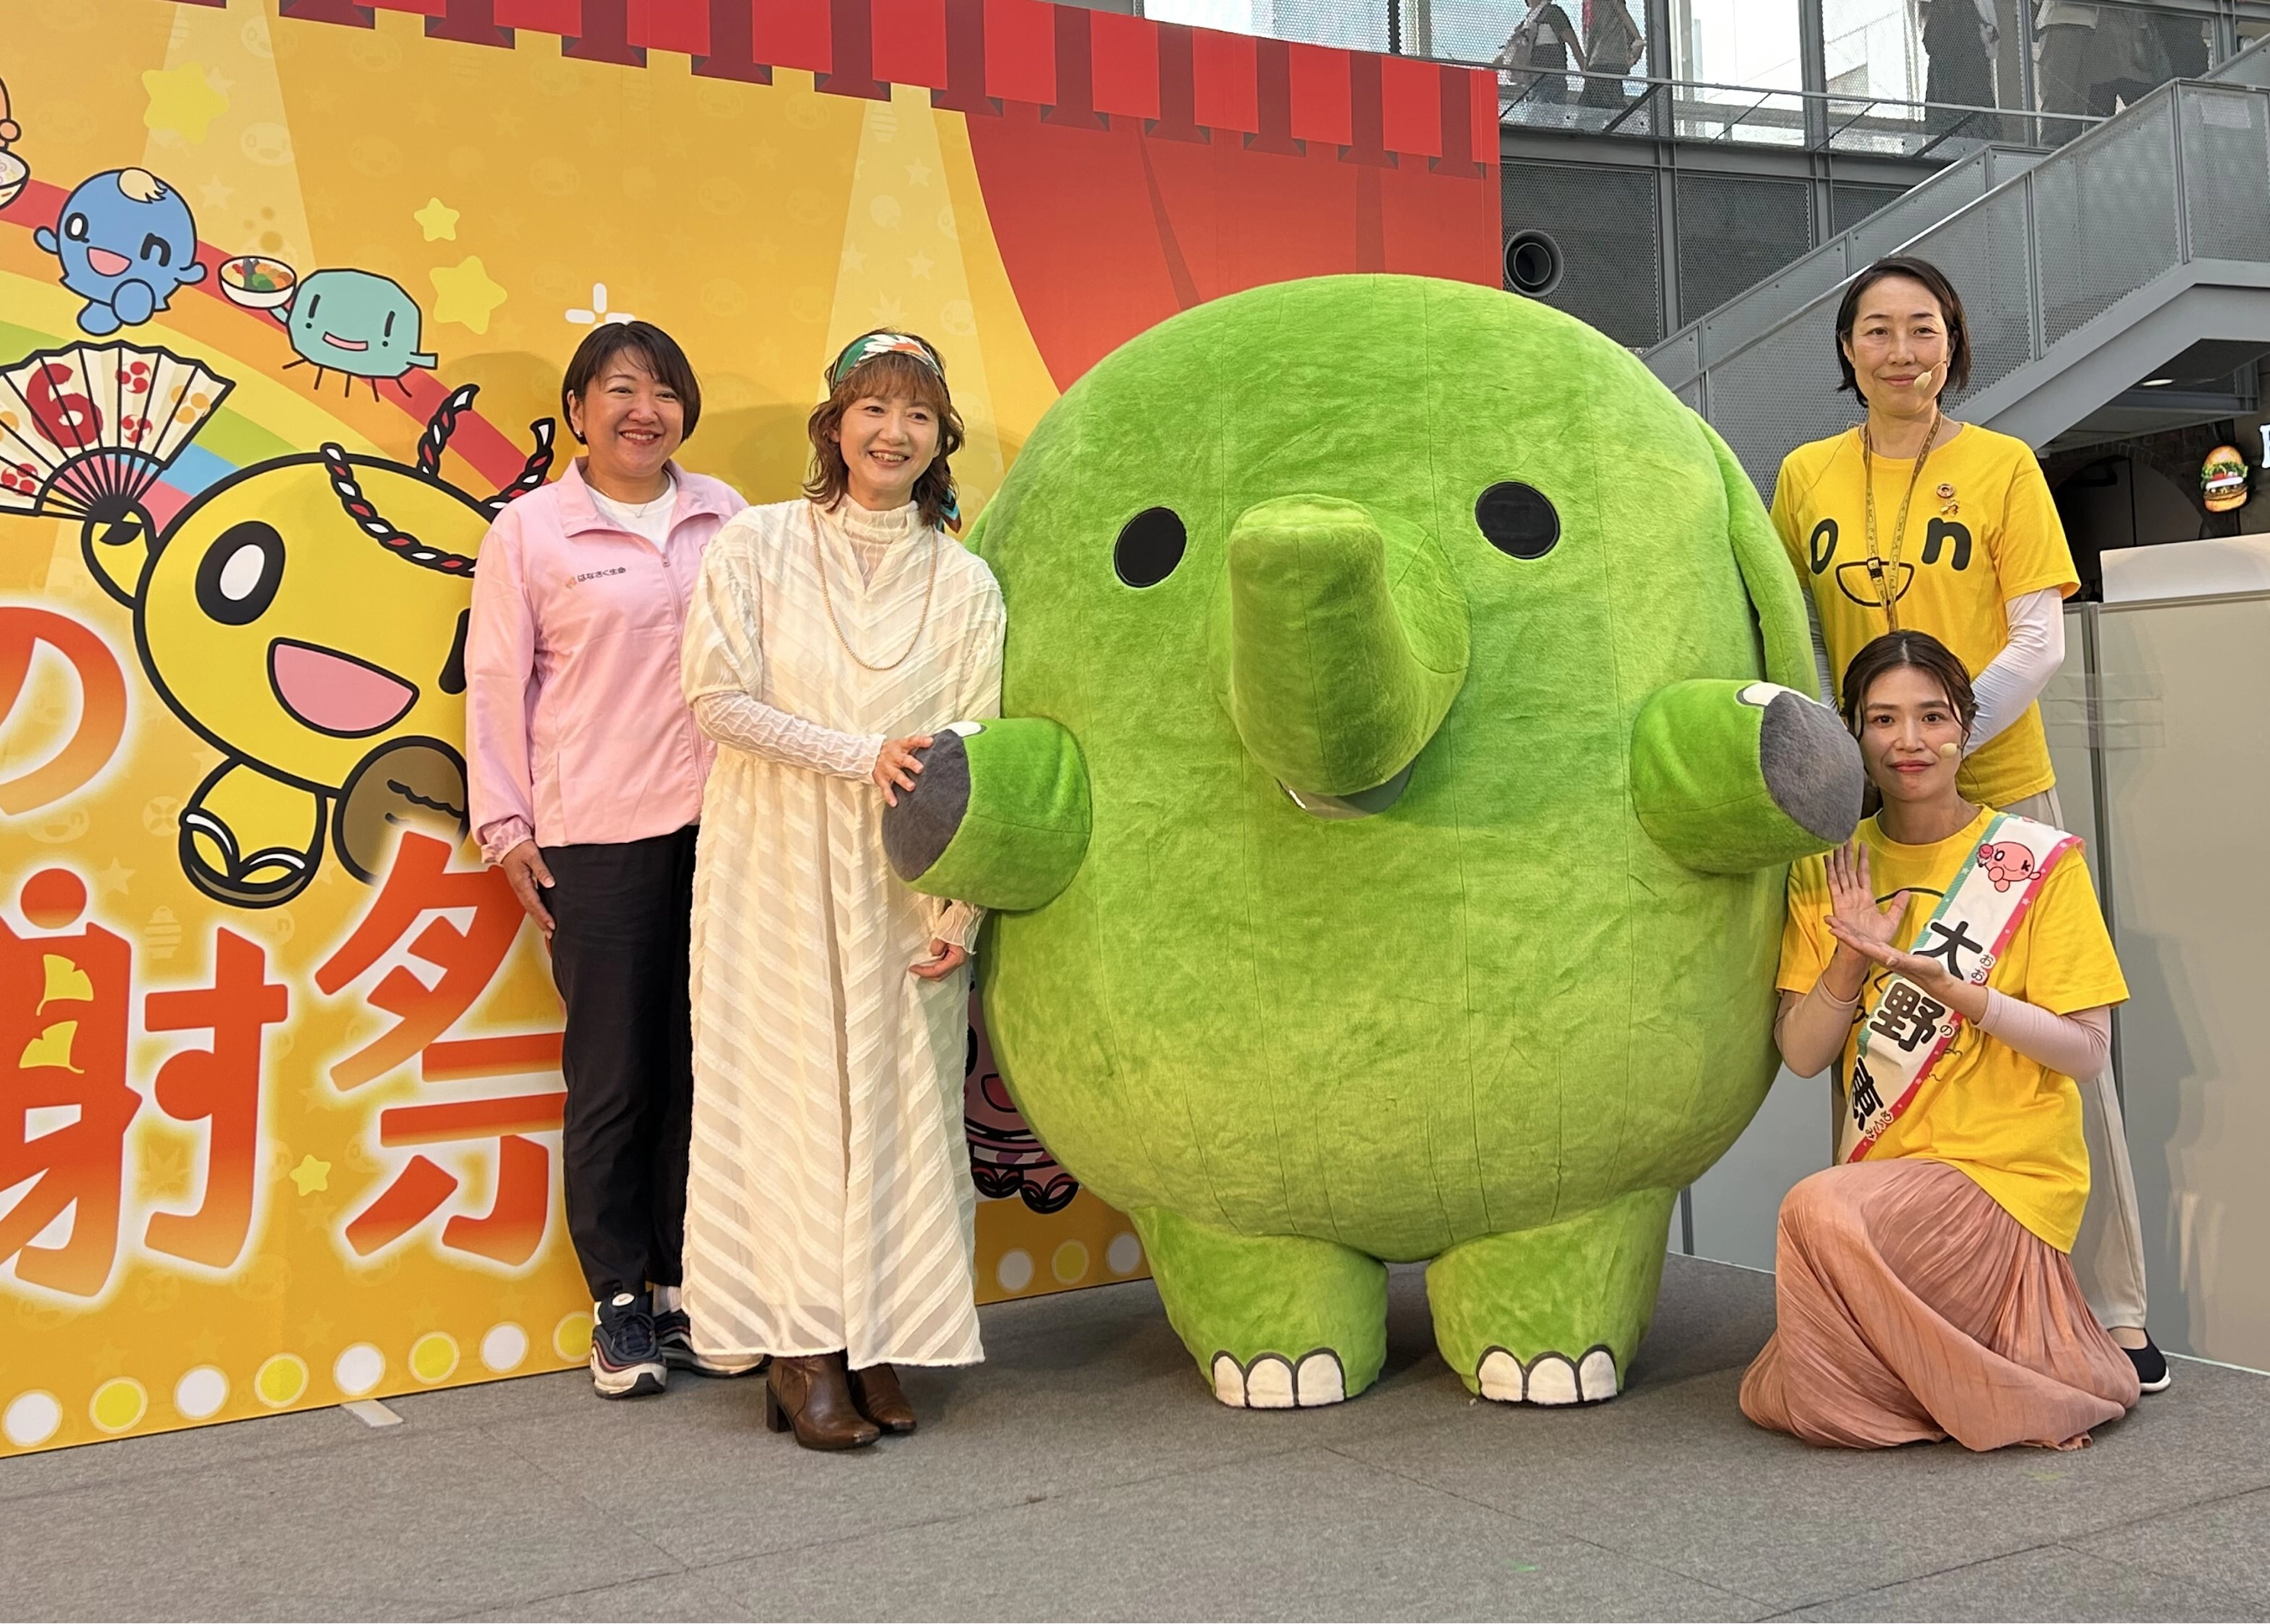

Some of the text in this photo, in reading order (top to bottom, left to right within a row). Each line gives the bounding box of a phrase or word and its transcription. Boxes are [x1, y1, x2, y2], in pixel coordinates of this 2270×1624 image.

[26, 363, 103, 448] 6
[577, 567, 626, 582] はなさく生命
